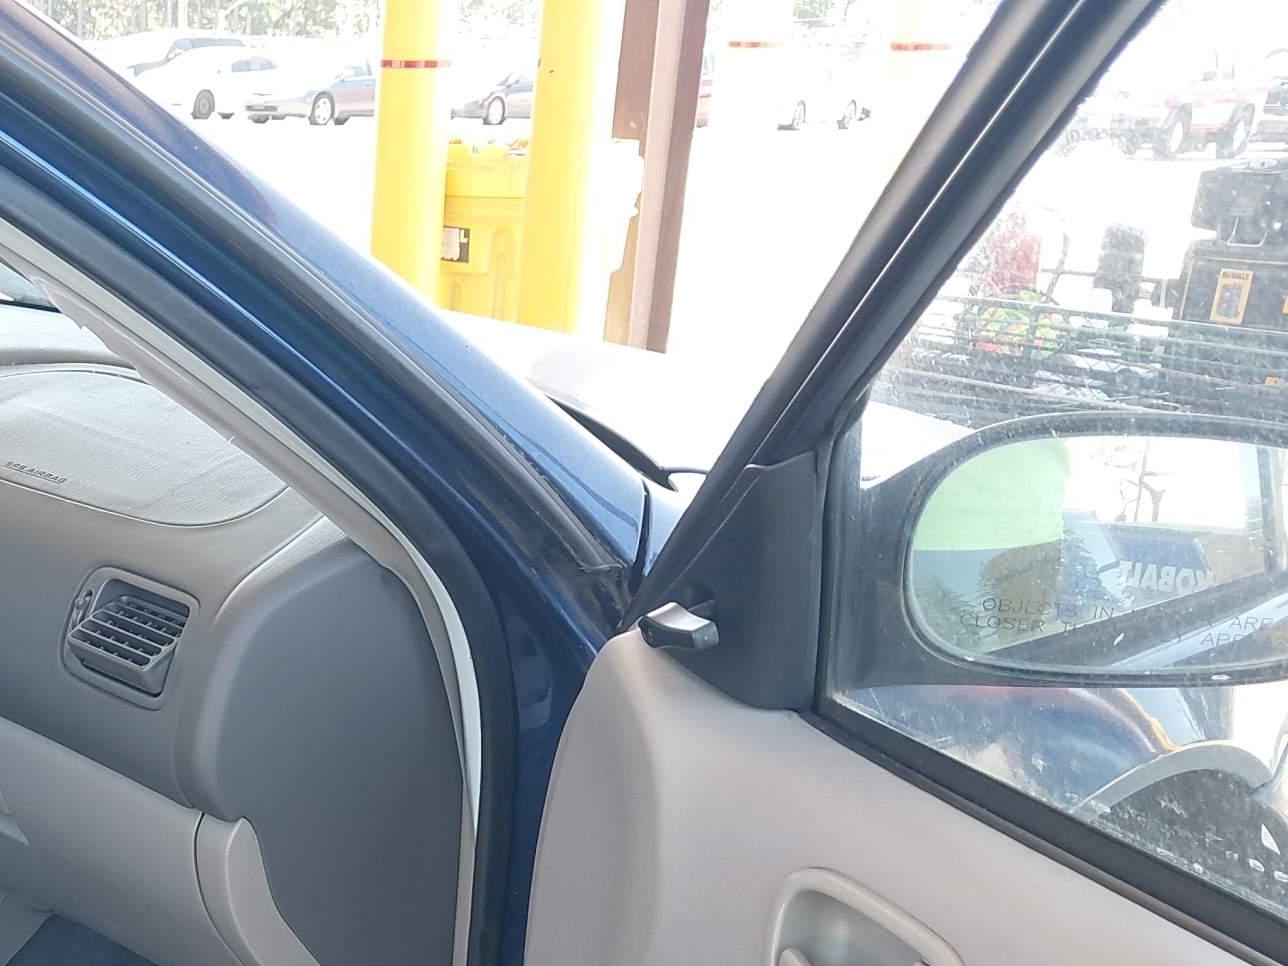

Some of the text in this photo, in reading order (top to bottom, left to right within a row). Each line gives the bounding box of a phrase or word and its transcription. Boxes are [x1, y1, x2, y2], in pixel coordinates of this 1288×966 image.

[25, 468, 68, 483] AIRBAG
[982, 596, 1078, 618] OBJECTS
[960, 612, 1046, 634] CLOSER
